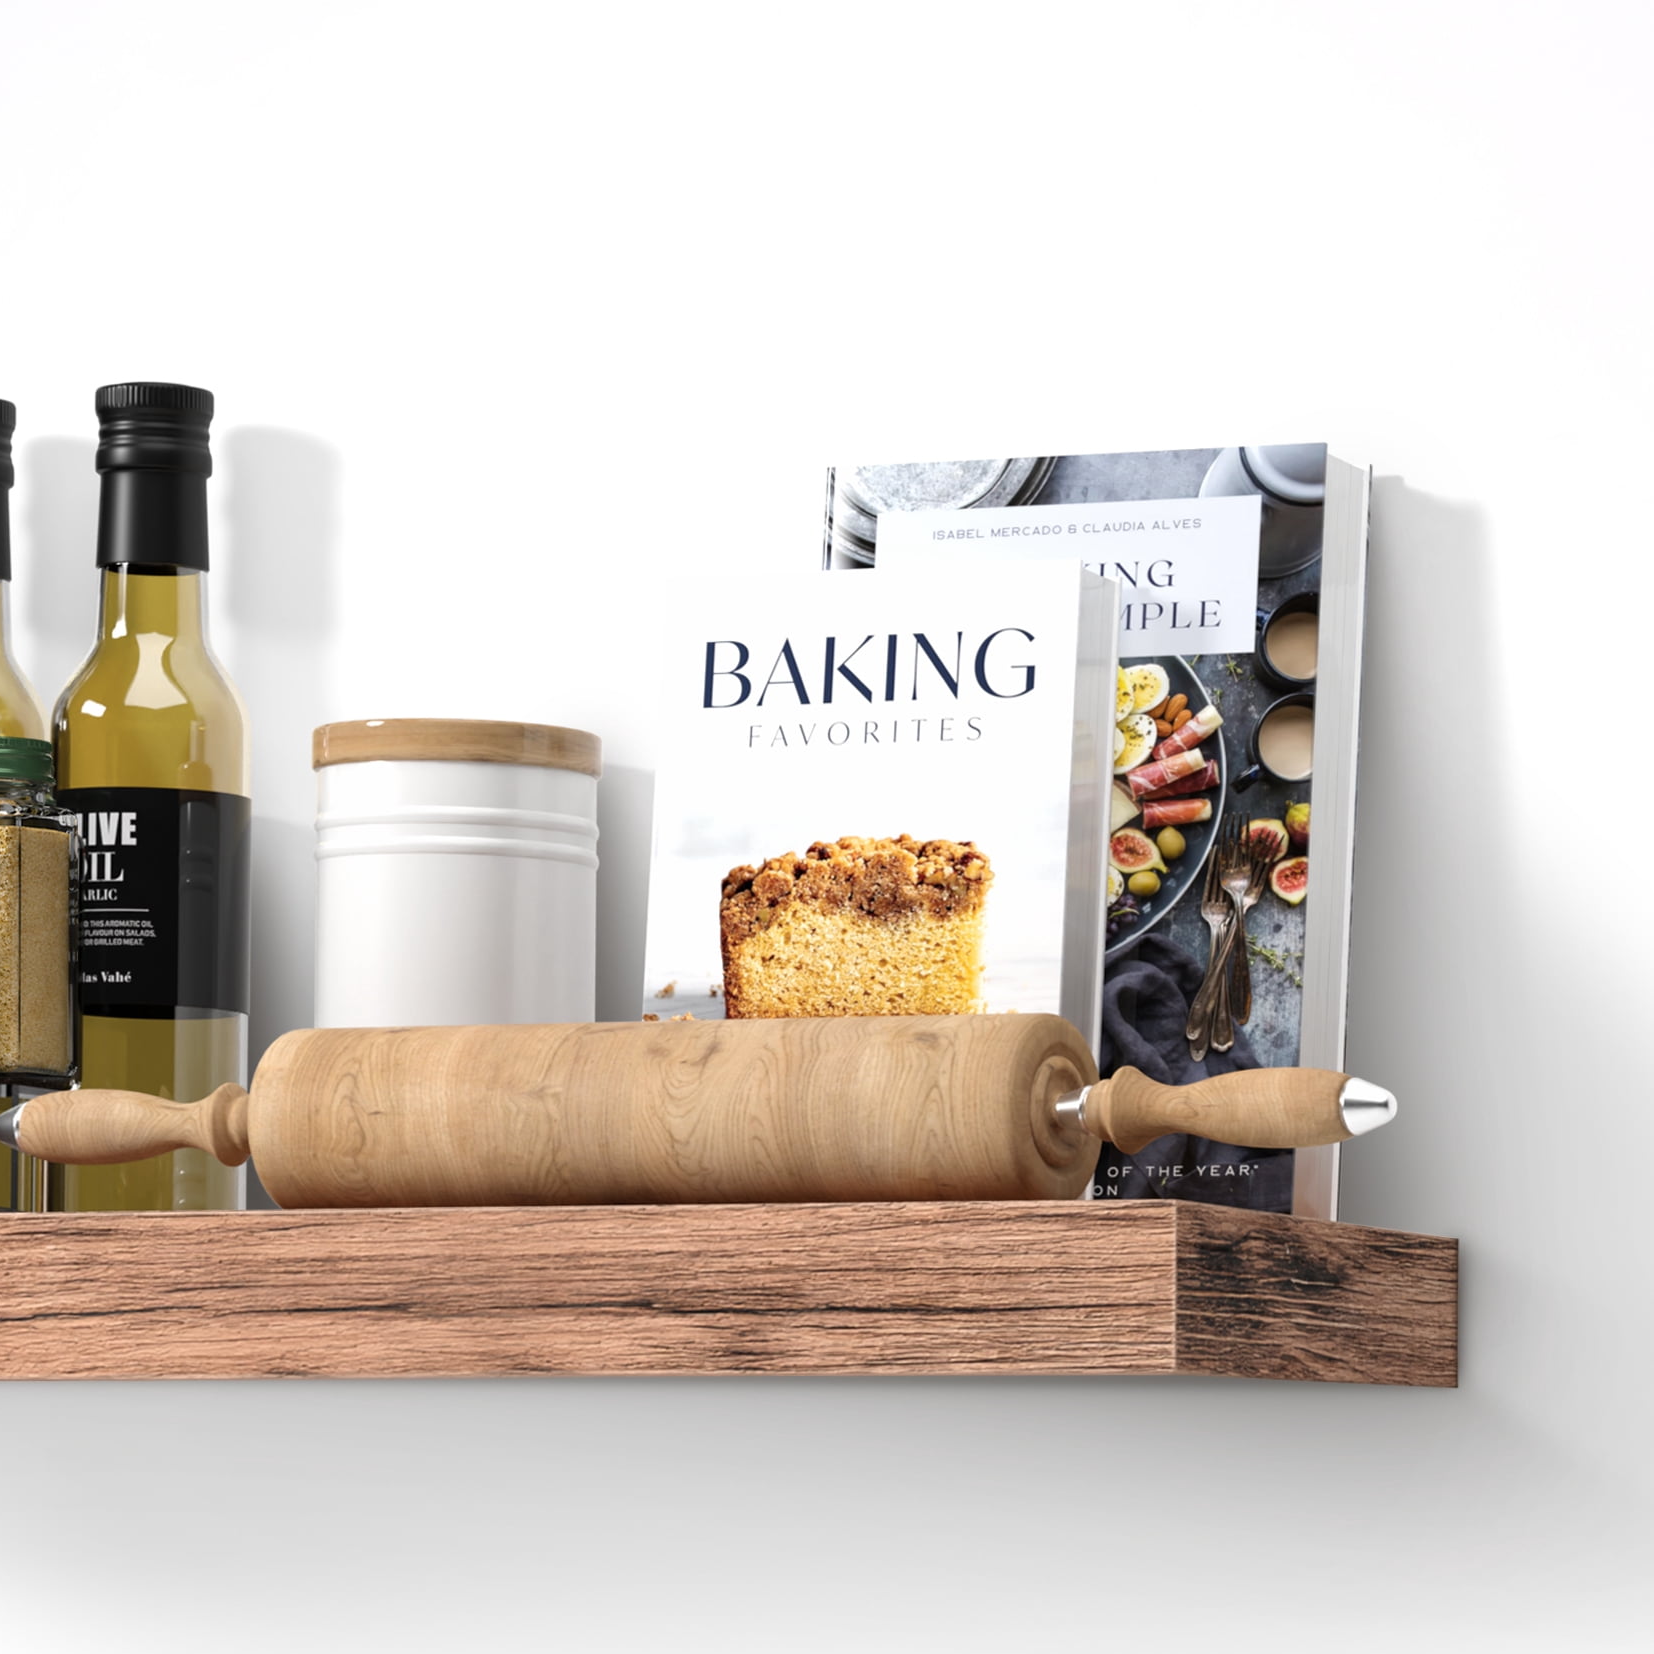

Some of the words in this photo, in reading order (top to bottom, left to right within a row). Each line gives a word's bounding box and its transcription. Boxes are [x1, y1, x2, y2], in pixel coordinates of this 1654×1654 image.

[932, 528, 985, 541] ISABEL
[990, 524, 1062, 538] MERCADO
[1082, 520, 1146, 534] CLAUDIA
[1151, 517, 1202, 530] ALVES
[1083, 558, 1175, 589] ING
[703, 627, 1036, 709] BAKING
[749, 716, 982, 748] FAVORITES
[82, 850, 125, 883] IL
[101, 971, 132, 983] Vahé
[1107, 1166, 1133, 1178] OF
[1145, 1165, 1184, 1177] THE
